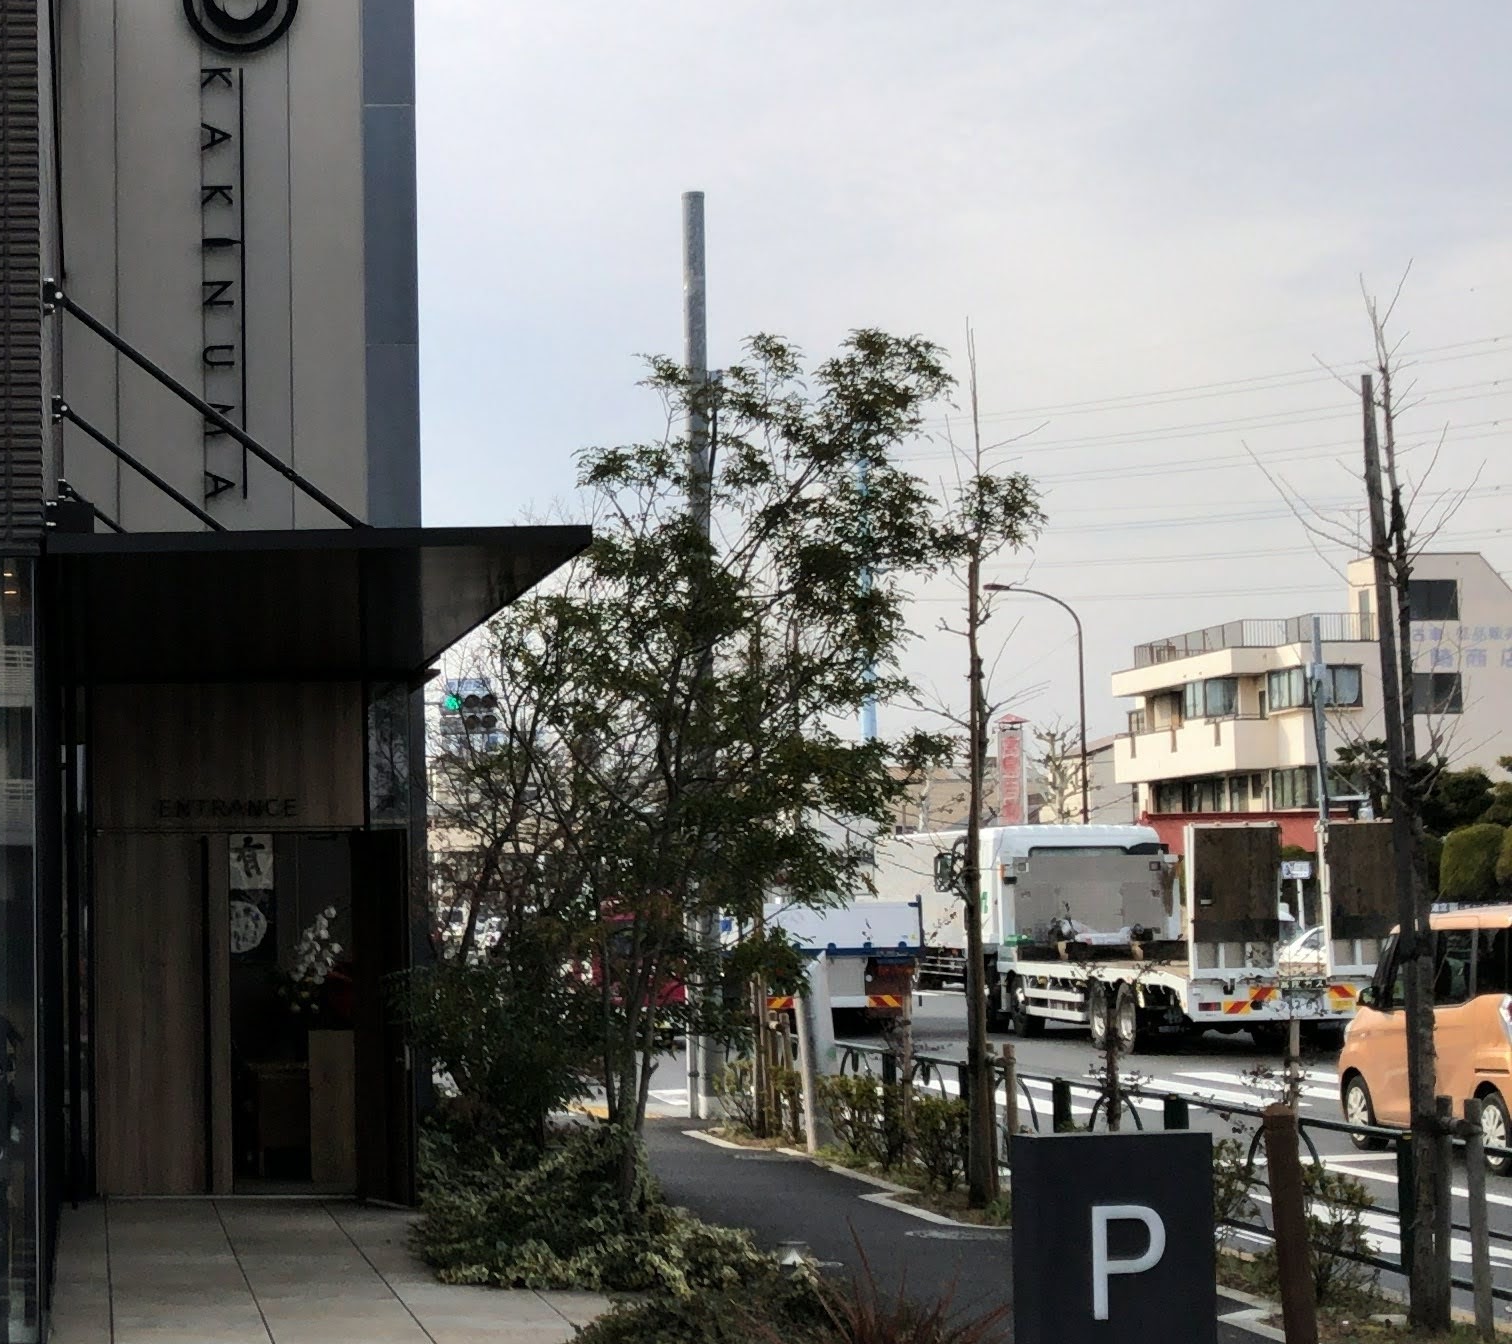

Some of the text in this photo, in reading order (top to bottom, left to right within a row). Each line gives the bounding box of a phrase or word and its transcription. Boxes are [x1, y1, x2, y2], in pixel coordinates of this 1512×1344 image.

[201, 67, 237, 499] KAKINUMA
[159, 798, 297, 818] ENTRANCE
[1091, 1204, 1167, 1321] P
